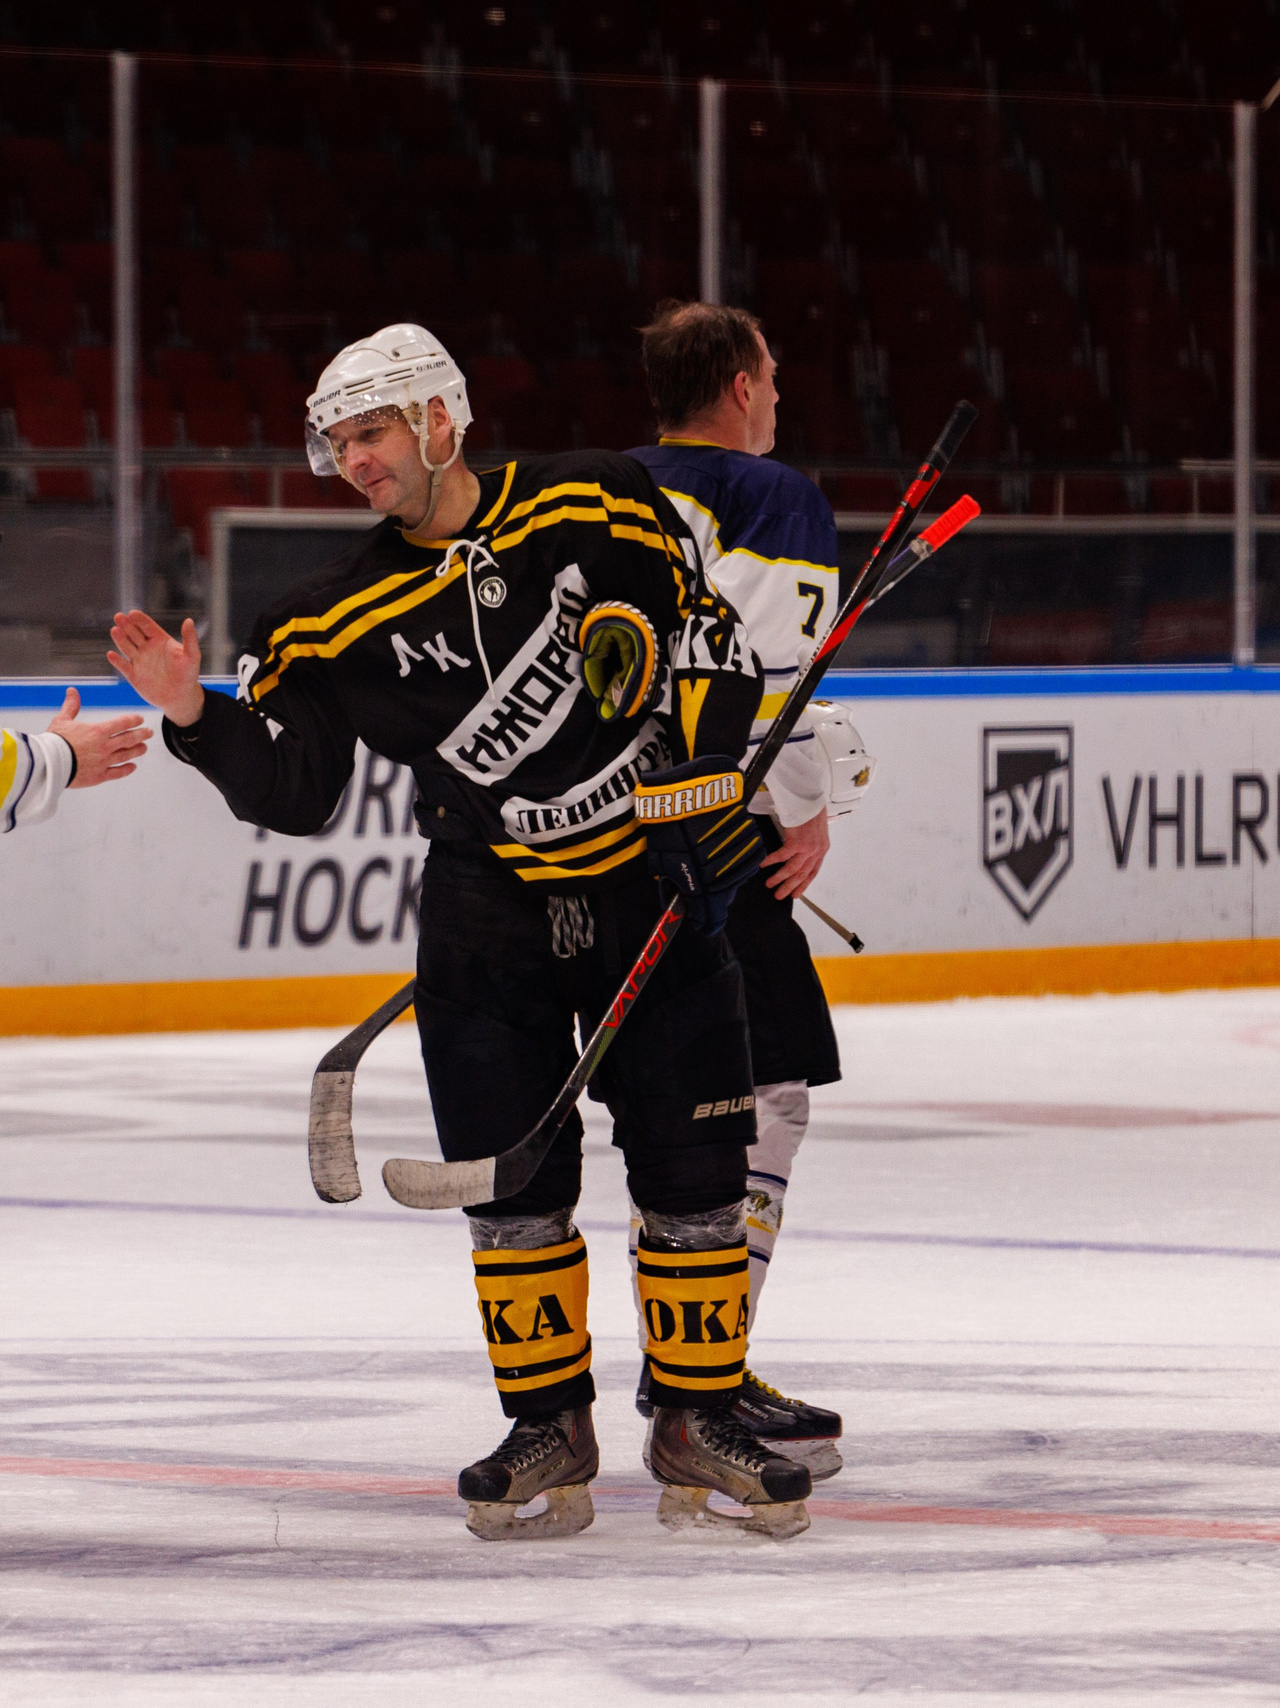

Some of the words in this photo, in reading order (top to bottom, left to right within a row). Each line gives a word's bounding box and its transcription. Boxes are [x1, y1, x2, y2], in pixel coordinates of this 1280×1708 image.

[797, 578, 825, 640] 7
[635, 773, 738, 819] ARRIOR
[984, 765, 1069, 862] ВХЛ
[1100, 770, 1280, 870] VHLR
[601, 909, 684, 1029] VAPOR
[693, 1095, 755, 1121] BAUE
